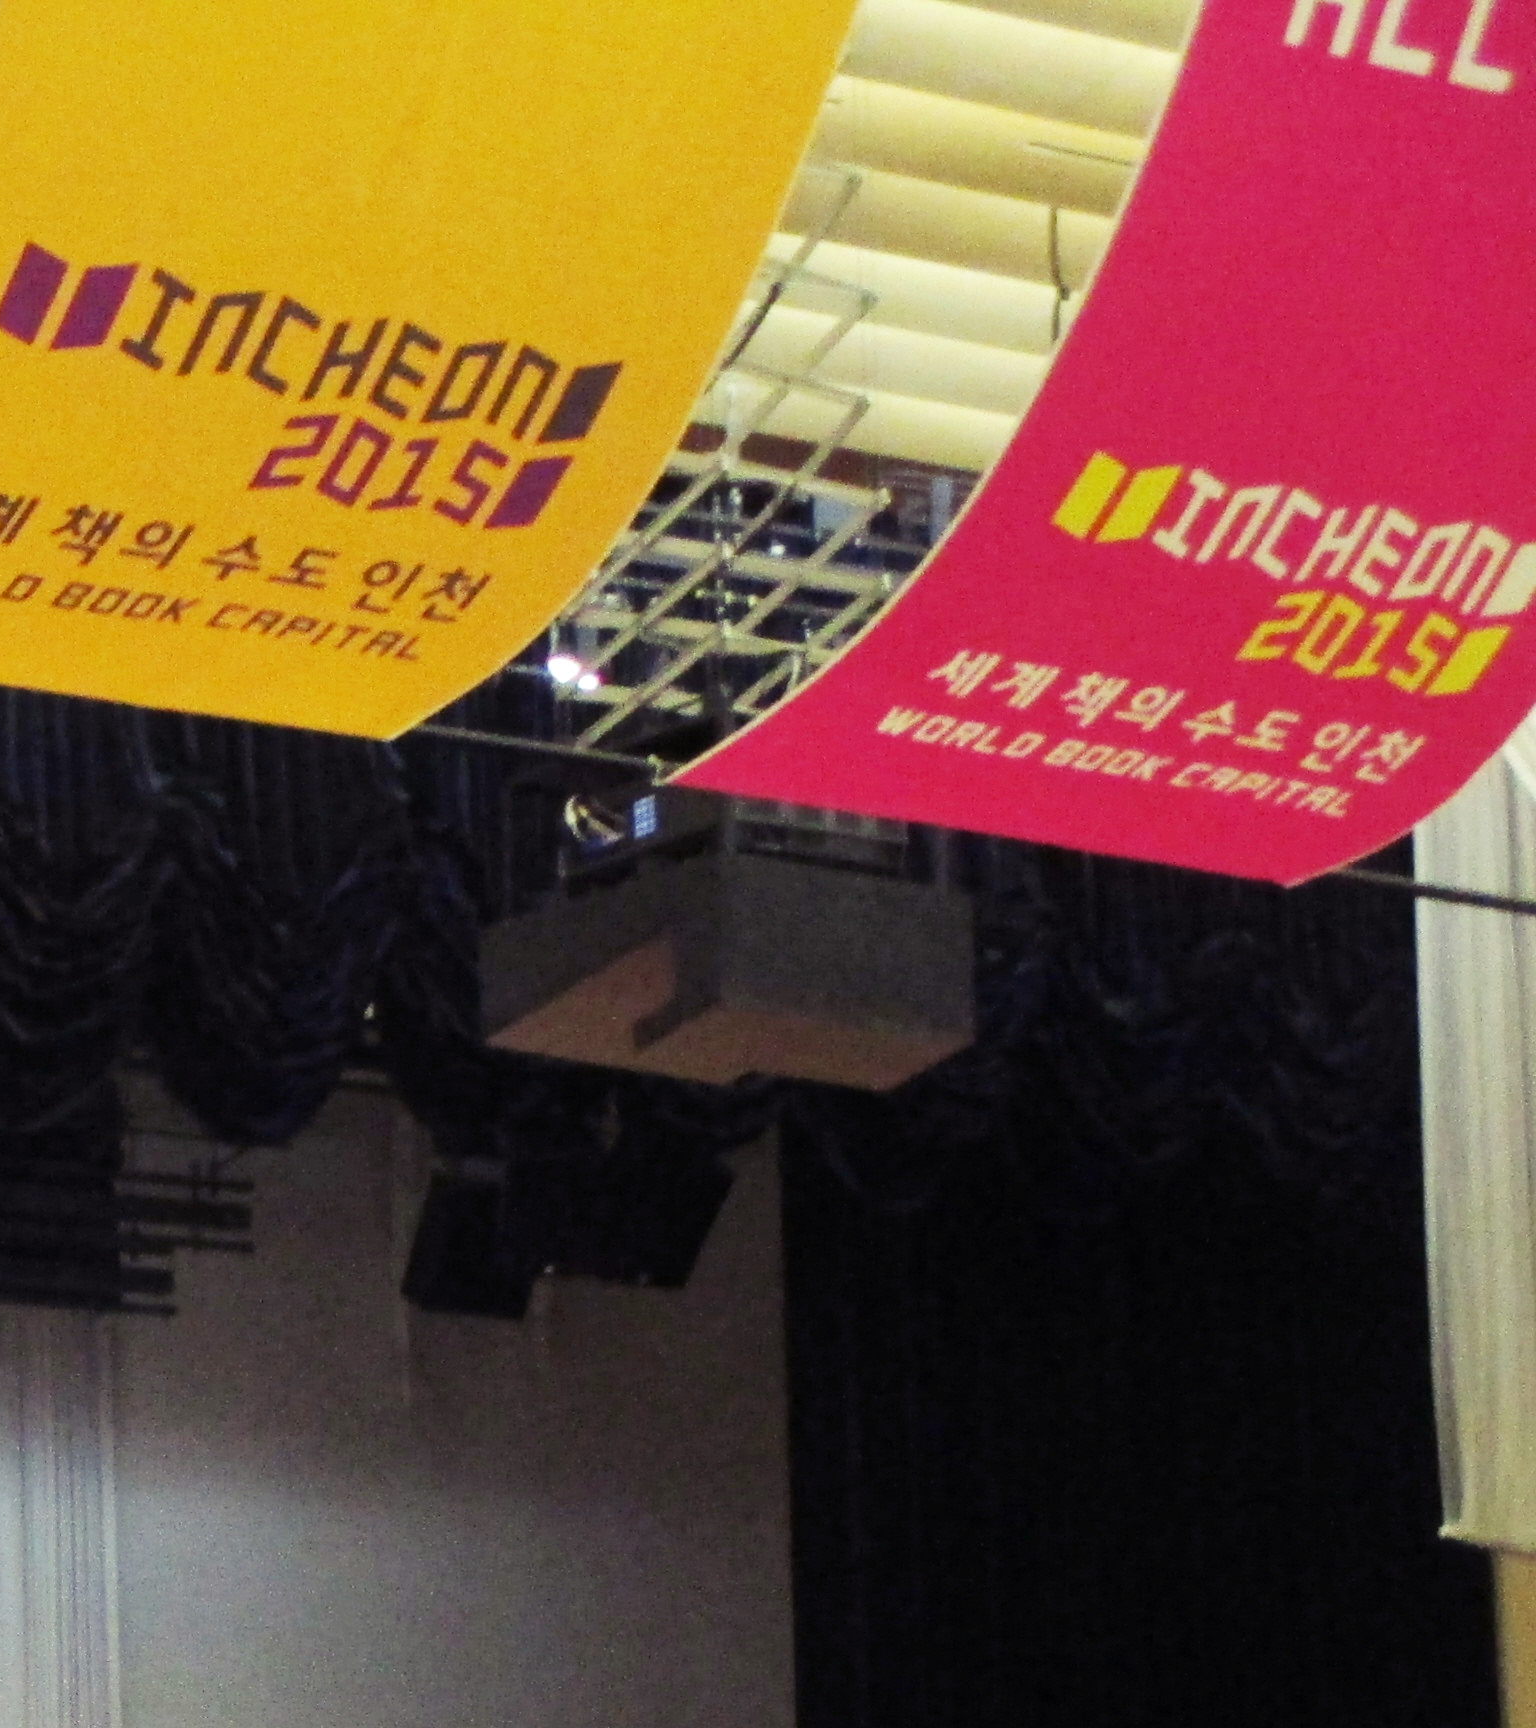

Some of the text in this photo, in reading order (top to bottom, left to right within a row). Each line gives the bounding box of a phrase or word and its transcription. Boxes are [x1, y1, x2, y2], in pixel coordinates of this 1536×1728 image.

[119, 266, 561, 441] INCHEON
[249, 414, 508, 527] 2015
[52, 503, 195, 570] 책의
[203, 535, 339, 590] 수도
[353, 558, 491, 624] 인천
[1152, 467, 1511, 616] INCHEON
[50, 580, 201, 624] BOOK
[206, 603, 422, 661] CAPITAL
[1235, 589, 1460, 694] 2015
[877, 705, 1354, 819] WORLD BOOK CAPITAL
[929, 650, 1426, 784] 세계 책의 수도 인천
